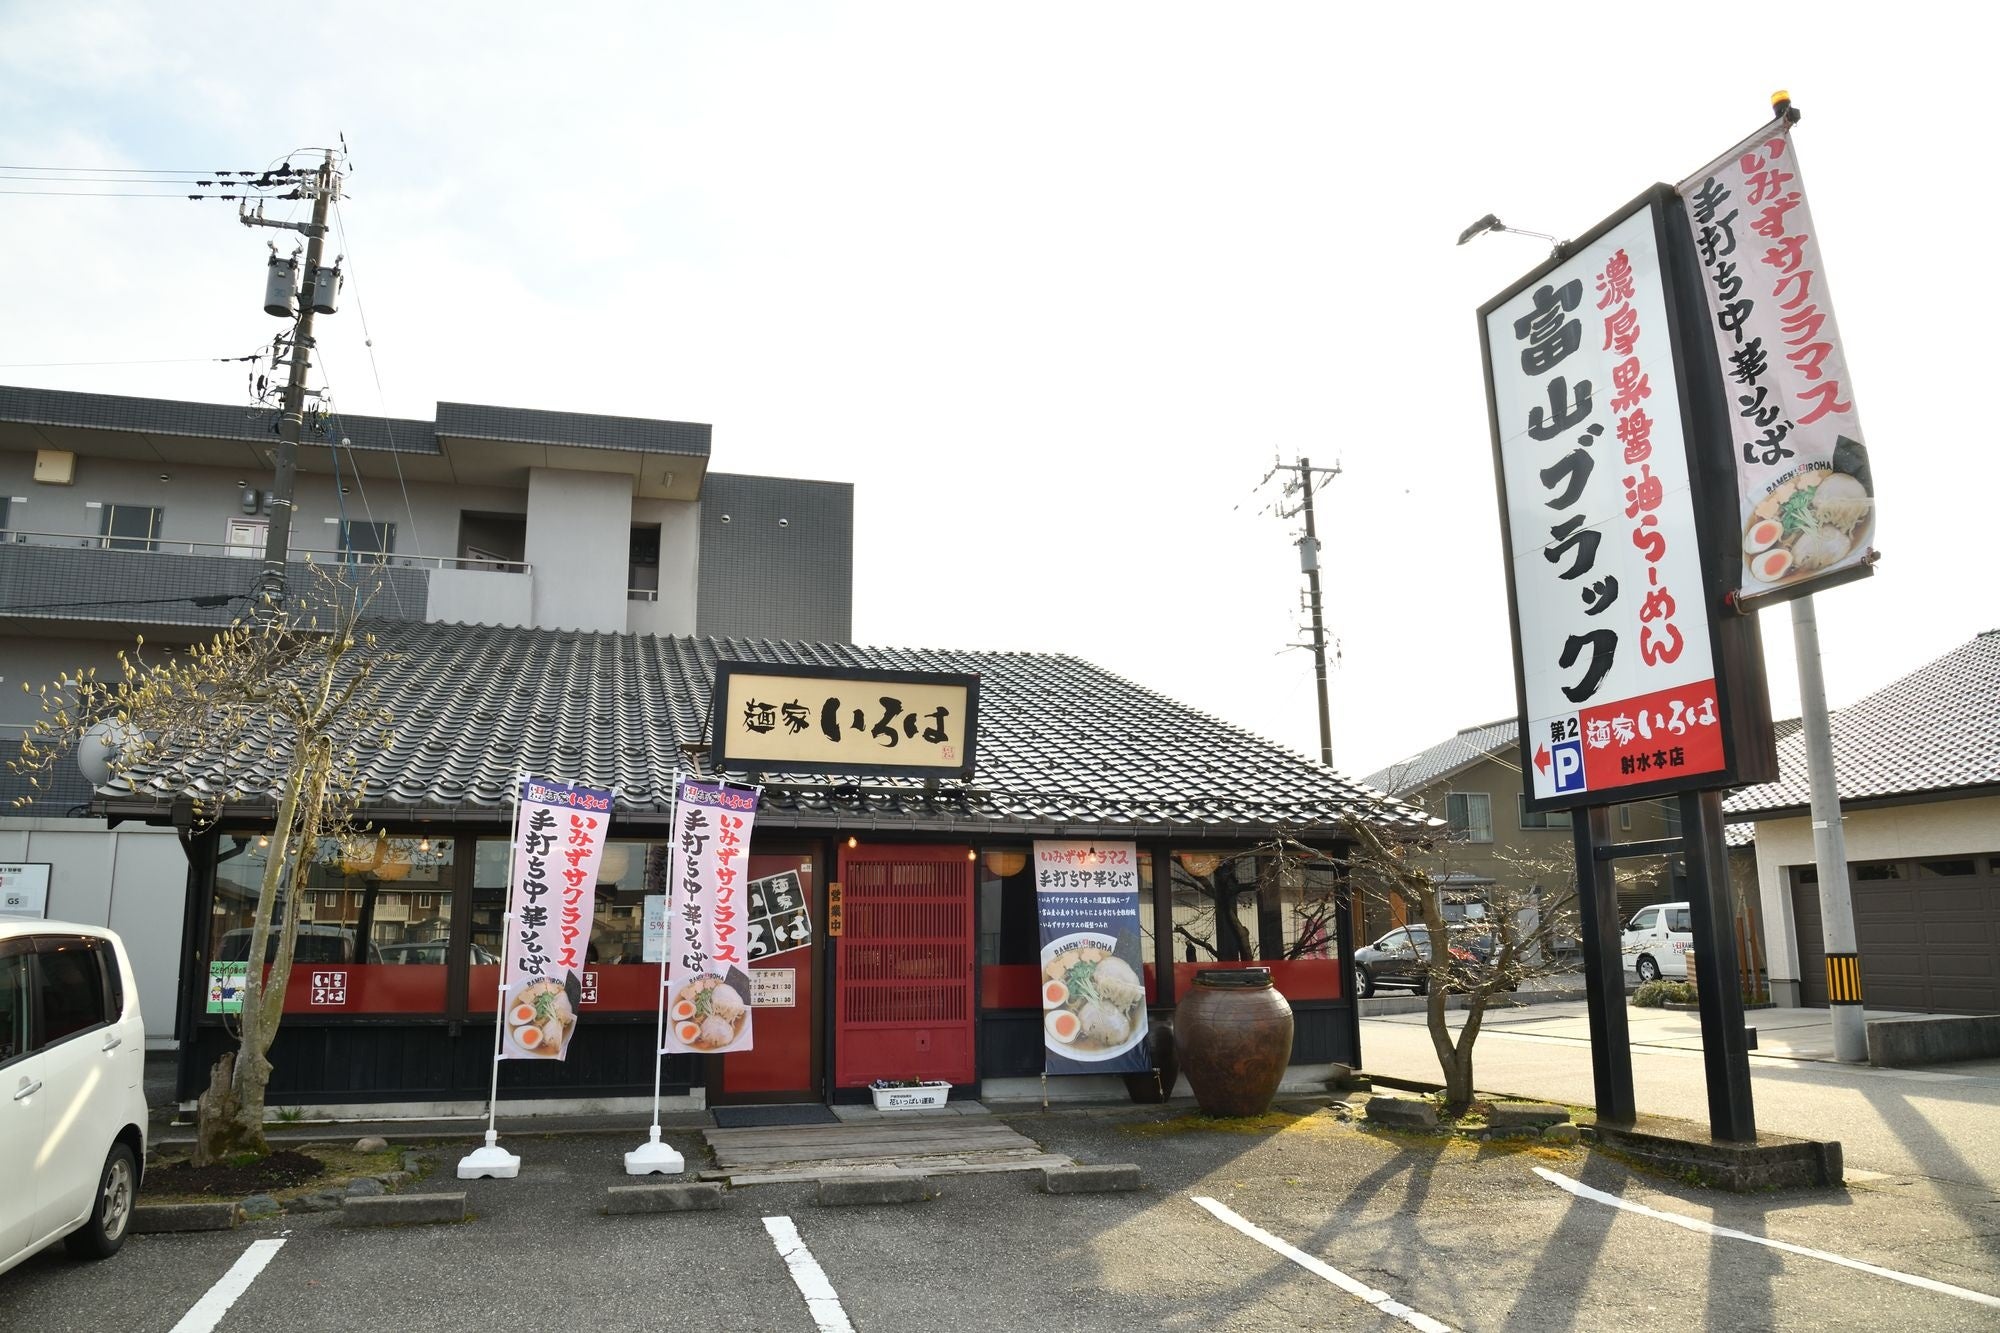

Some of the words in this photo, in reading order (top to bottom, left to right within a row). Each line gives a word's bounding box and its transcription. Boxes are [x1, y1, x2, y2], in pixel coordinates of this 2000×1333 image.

[1693, 176, 1794, 465] 手打ち中華そば
[1740, 138, 1852, 425] いみずサクラマス
[1513, 278, 1619, 704] 富山ブラック
[1595, 249, 1684, 667] 濃厚黒醤油らーめん
[1766, 471, 1794, 494] RAMEN
[1805, 461, 1833, 472] IROHA
[1550, 718, 1579, 743] 第2
[1556, 747, 1580, 787] P
[1586, 697, 1717, 750] 麺家いろは
[1621, 747, 1684, 775] 射水本店
[519, 808, 558, 975] 手打ち中華そば
[557, 814, 598, 968] いみずサクラマス
[681, 808, 710, 973] 手打ち中華そば
[712, 814, 743, 963] いみずサクラマス
[1040, 869, 1135, 888] 手打ち中華そば
[1041, 850, 1129, 864] いみずサラマス
[1054, 941, 1078, 955] RAMEN
[1088, 940, 1112, 952] IROHA
